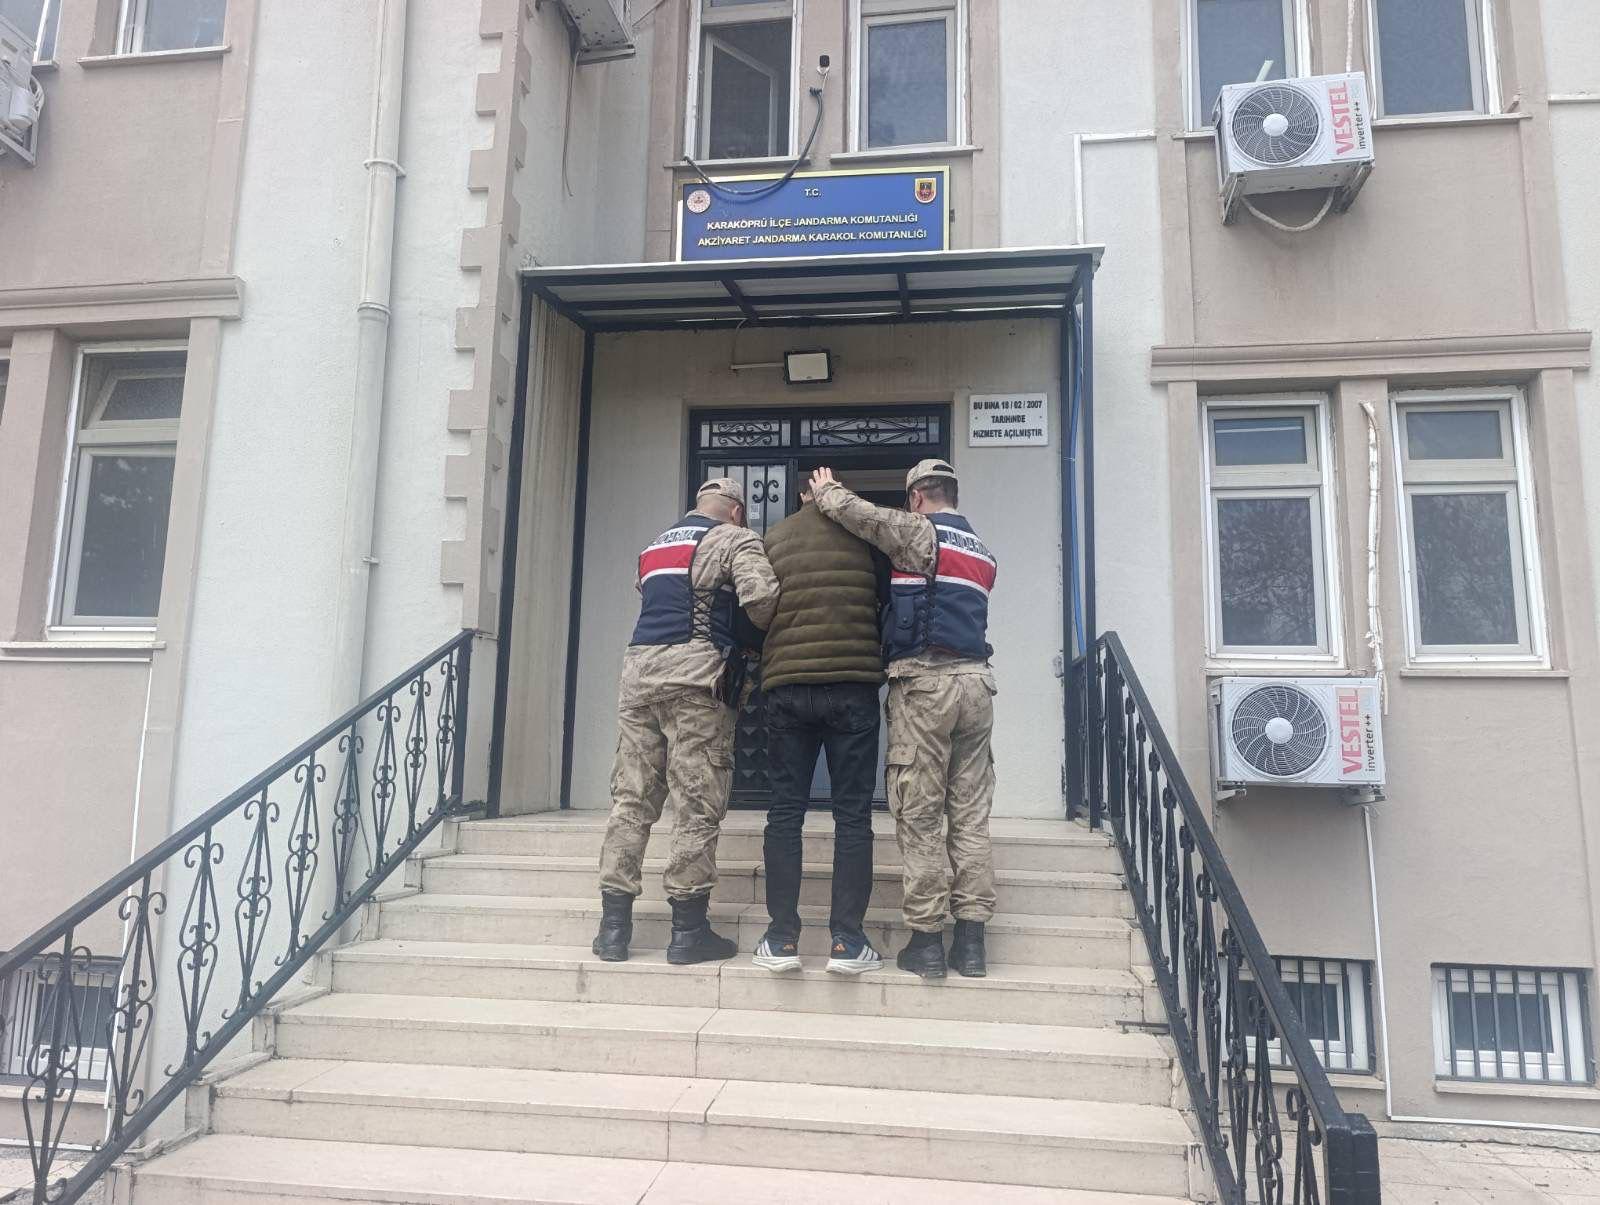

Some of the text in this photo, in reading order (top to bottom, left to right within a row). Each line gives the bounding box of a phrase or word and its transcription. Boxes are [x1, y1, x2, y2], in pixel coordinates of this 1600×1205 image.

[1328, 81, 1354, 155] VESTEL
[804, 188, 822, 196] T.C.
[769, 216, 791, 229] İLÇE
[793, 215, 848, 228] JANDARMA
[850, 213, 918, 225] KOMUTANLIĞI
[697, 230, 927, 247] AKZİYARET JANDARMA KARAKOL KOMUTANLIĞI
[973, 401, 983, 410] BU
[1027, 401, 1043, 409] 2007
[1338, 689, 1362, 774] VESTEL
